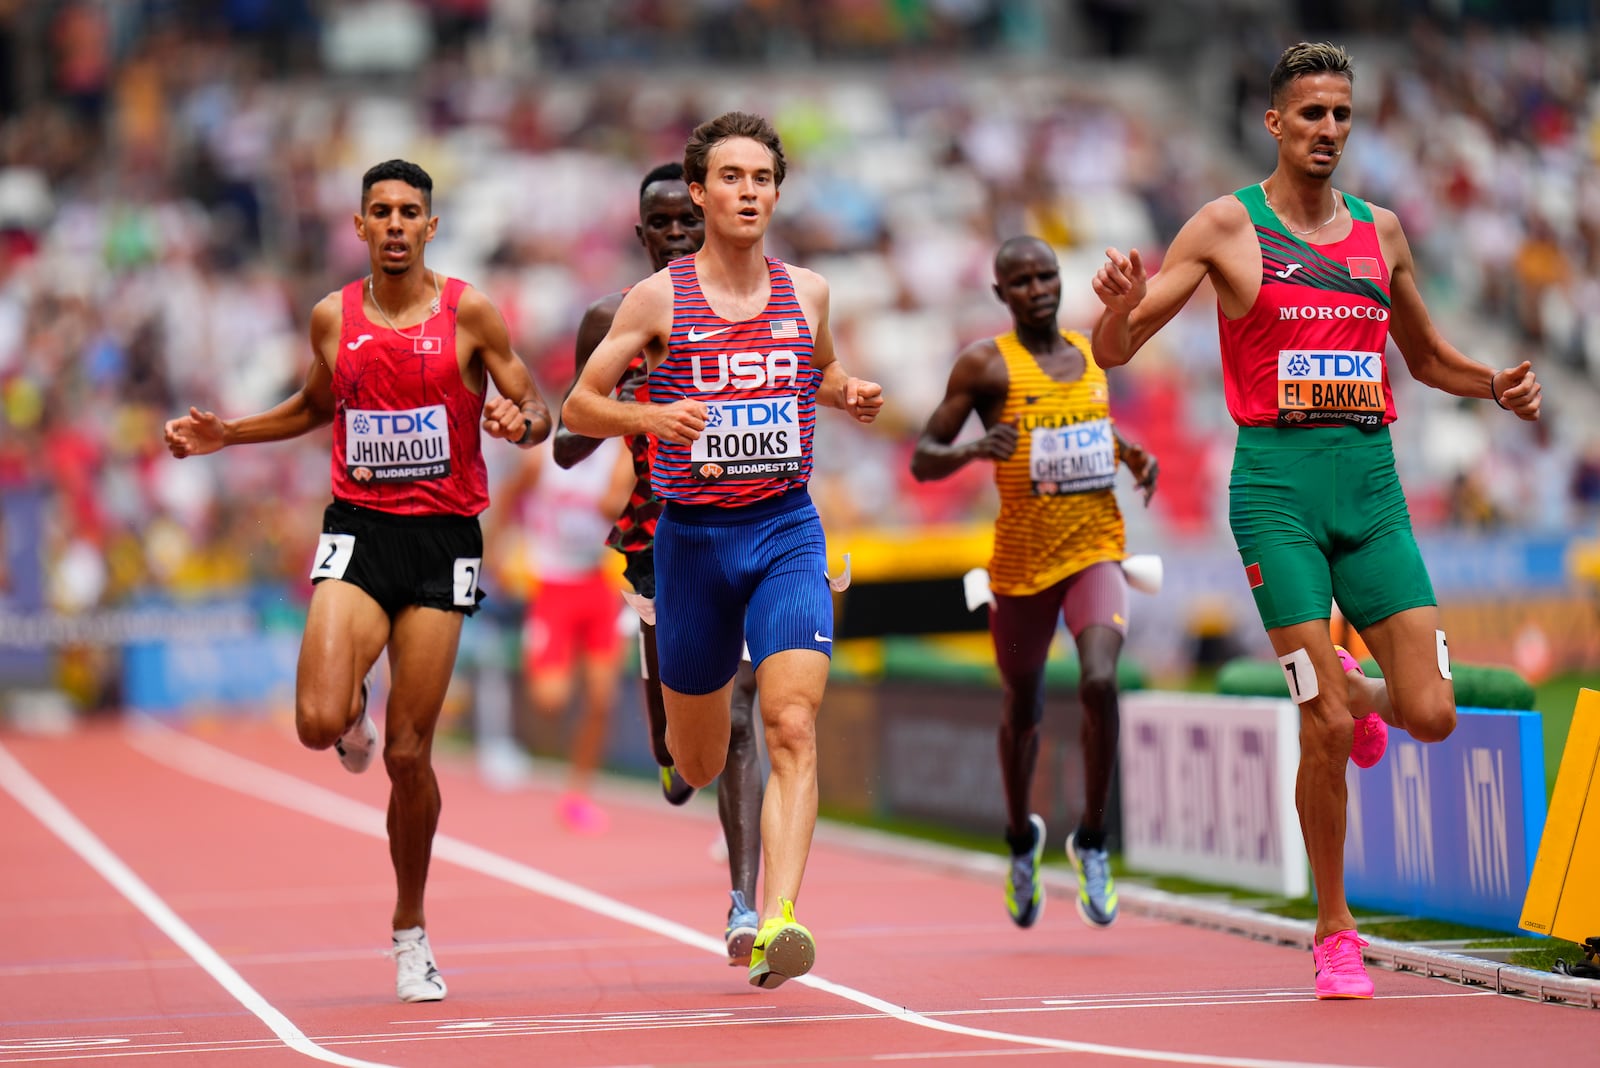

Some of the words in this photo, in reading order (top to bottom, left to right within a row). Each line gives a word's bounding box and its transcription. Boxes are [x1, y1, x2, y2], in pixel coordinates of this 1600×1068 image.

[1279, 305, 1388, 321] MOROCCO
[690, 350, 798, 392] USA
[1310, 354, 1374, 378] TDK
[1284, 383, 1306, 406] EL
[1312, 383, 1381, 408] BAKKALI
[369, 410, 438, 435] TDK
[722, 401, 792, 427] TDK
[1309, 411, 1367, 425] BUDAPEST
[1366, 415, 1378, 425] 23
[352, 436, 443, 463] JHINAOUI
[706, 431, 788, 458] ROOKS
[1058, 424, 1108, 450] TDK
[375, 466, 431, 479] BUDAPEST
[433, 464, 445, 475] 23
[727, 463, 786, 475] BUDAPEST
[787, 462, 799, 472] 23
[319, 542, 338, 569] 2
[464, 566, 474, 598] 2
